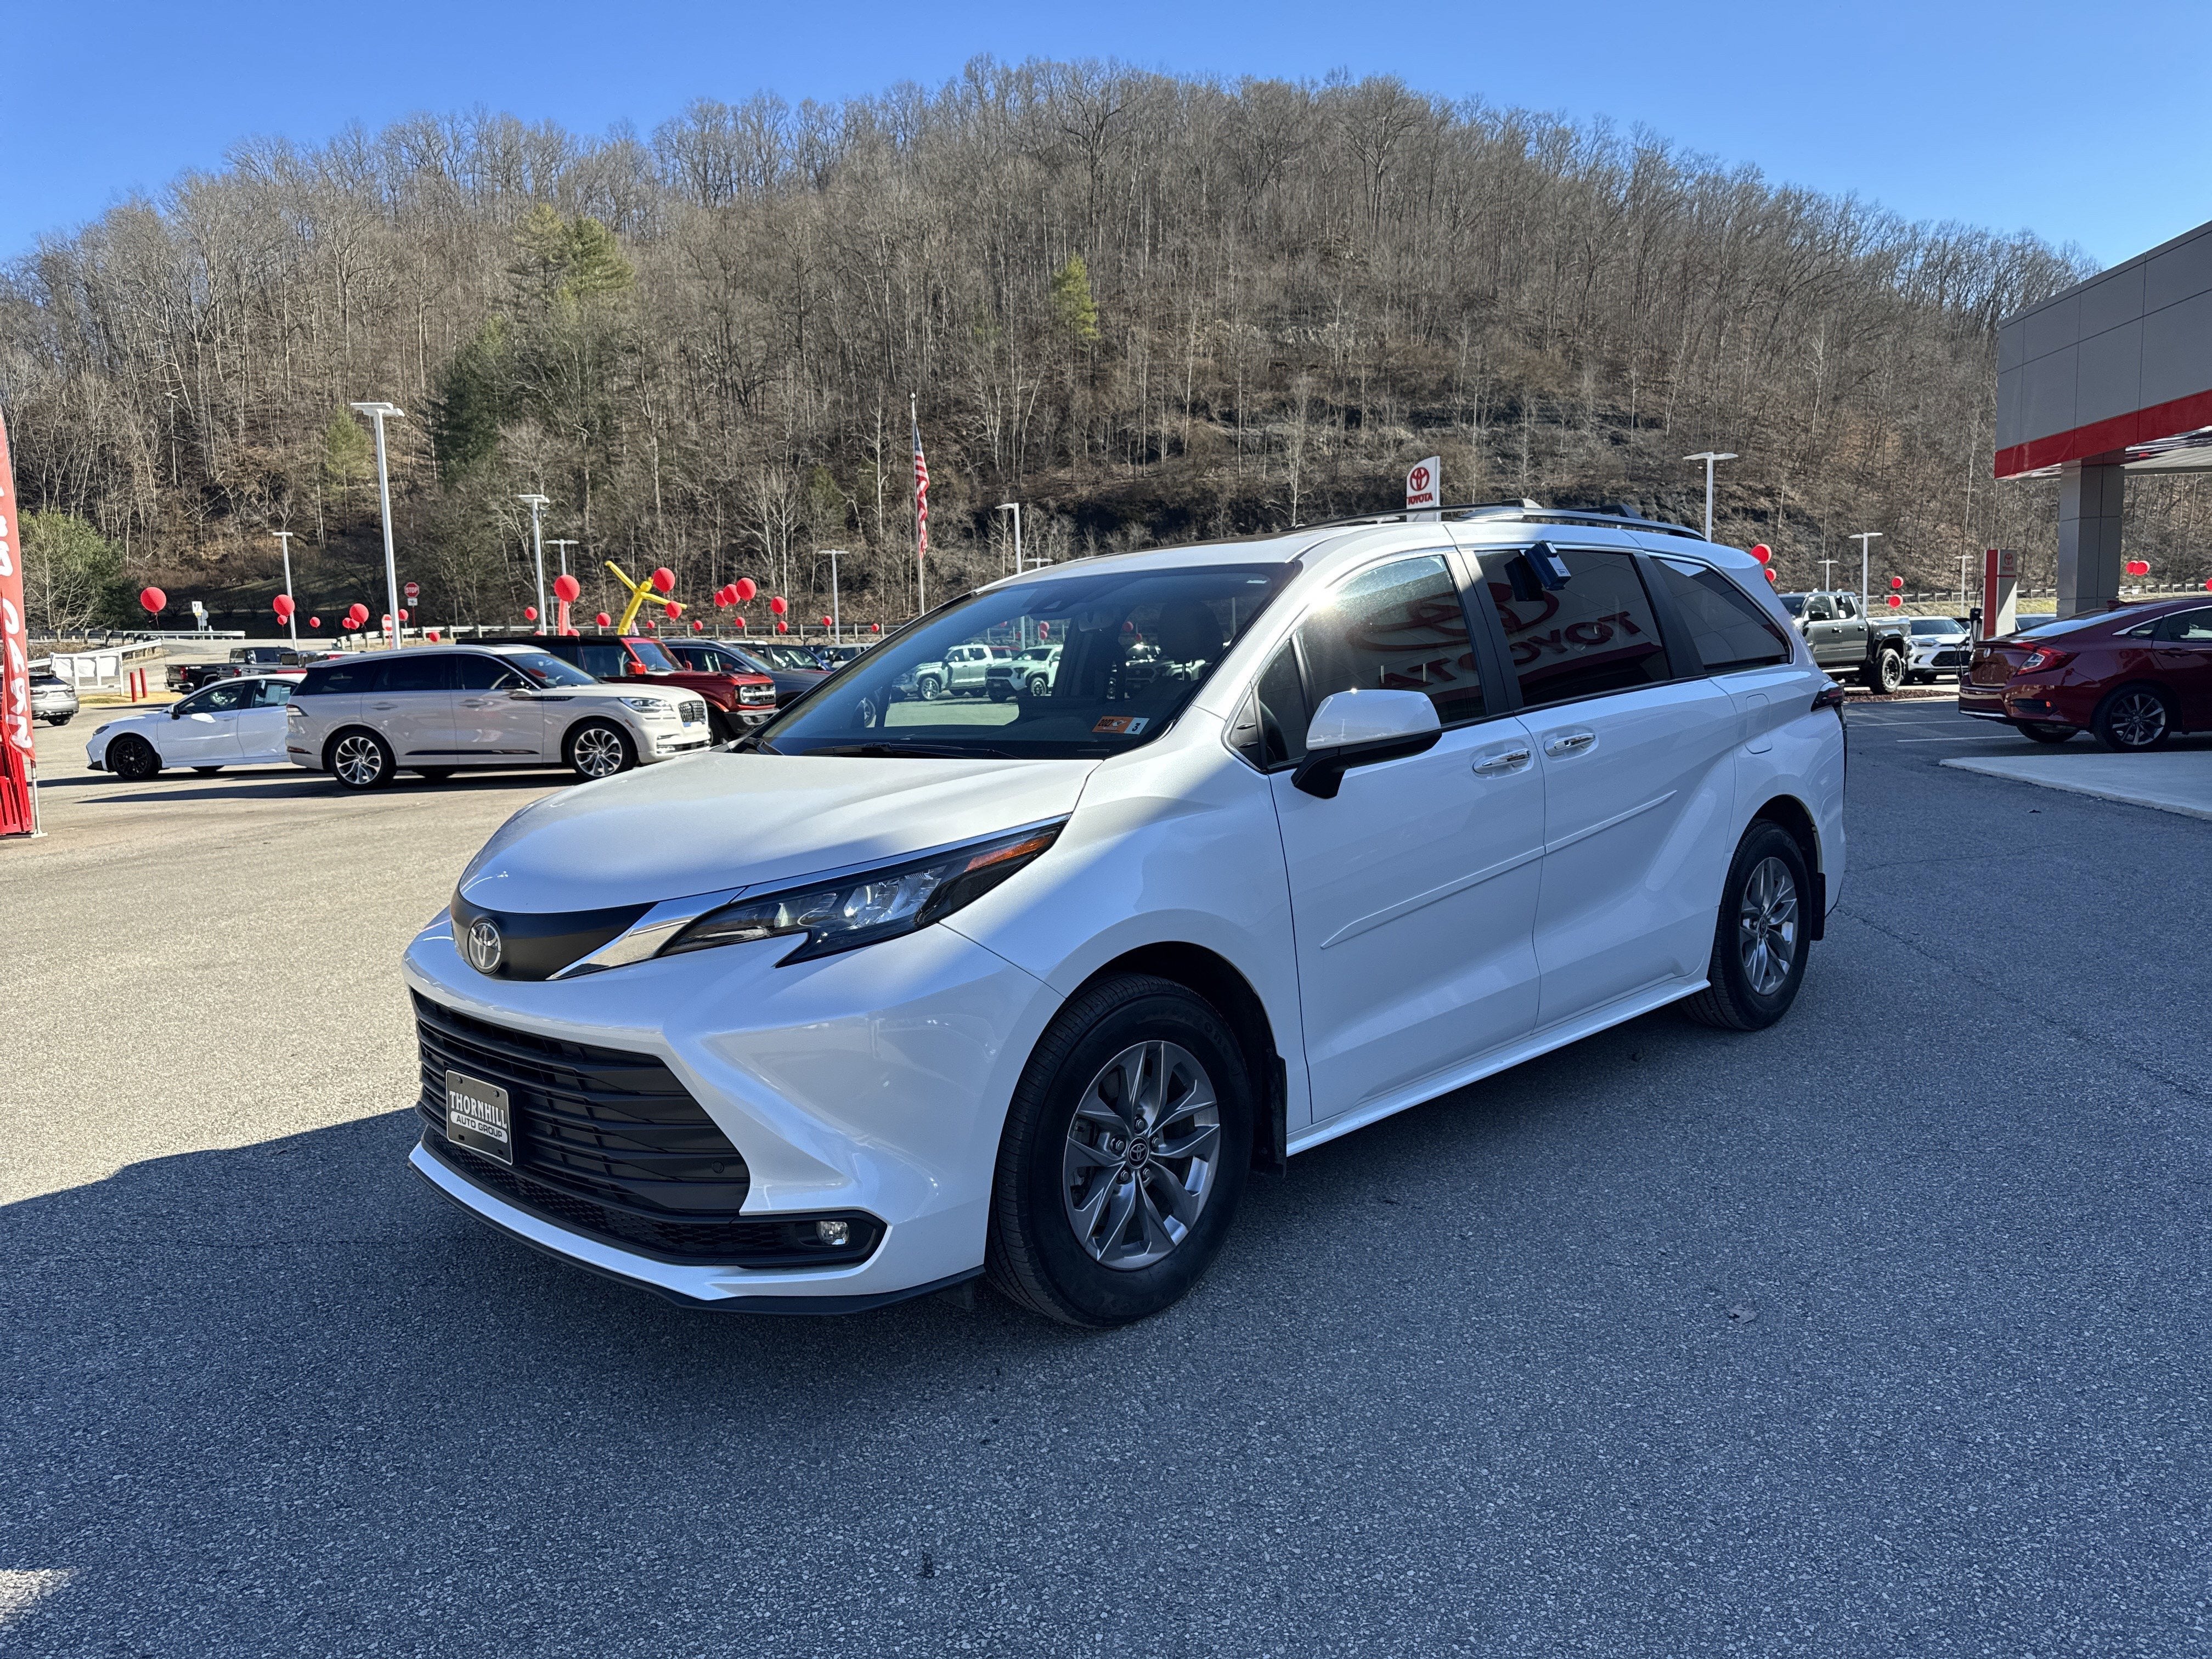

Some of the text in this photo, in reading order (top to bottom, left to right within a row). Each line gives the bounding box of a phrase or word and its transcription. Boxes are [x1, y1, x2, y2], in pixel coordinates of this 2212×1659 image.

[1408, 493, 1433, 505] TOYOTA
[1132, 723, 1141, 732] 3
[449, 1090, 507, 1129] THORNHILL
[456, 1115, 503, 1138] AUTO GROUP
